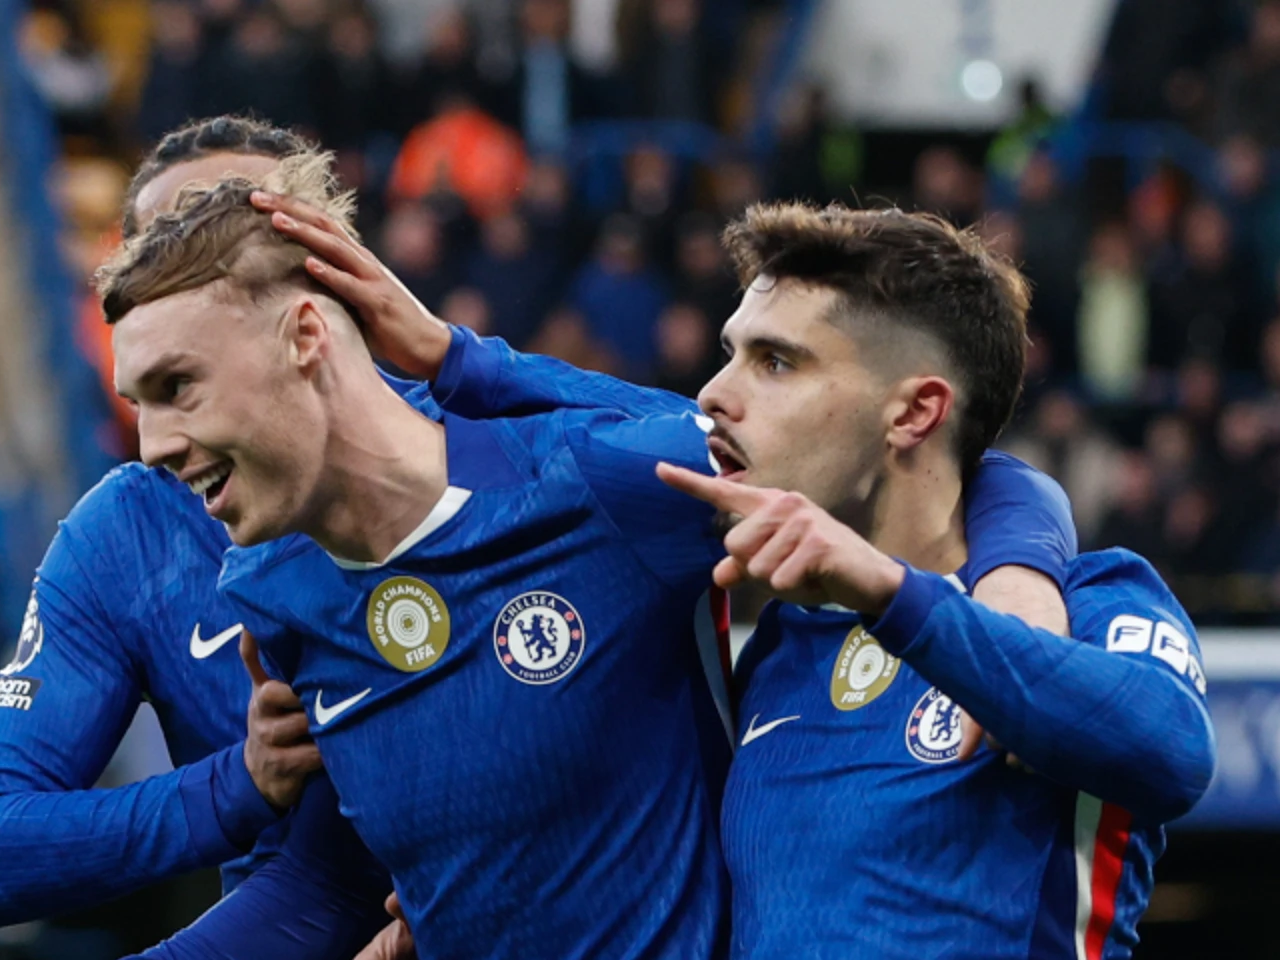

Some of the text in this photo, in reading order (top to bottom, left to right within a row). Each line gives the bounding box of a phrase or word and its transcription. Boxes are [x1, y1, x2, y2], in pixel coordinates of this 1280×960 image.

[374, 584, 442, 647] WORLD CHAMPIONS
[501, 595, 556, 625] CHELSEA
[405, 643, 436, 667] FIFA
